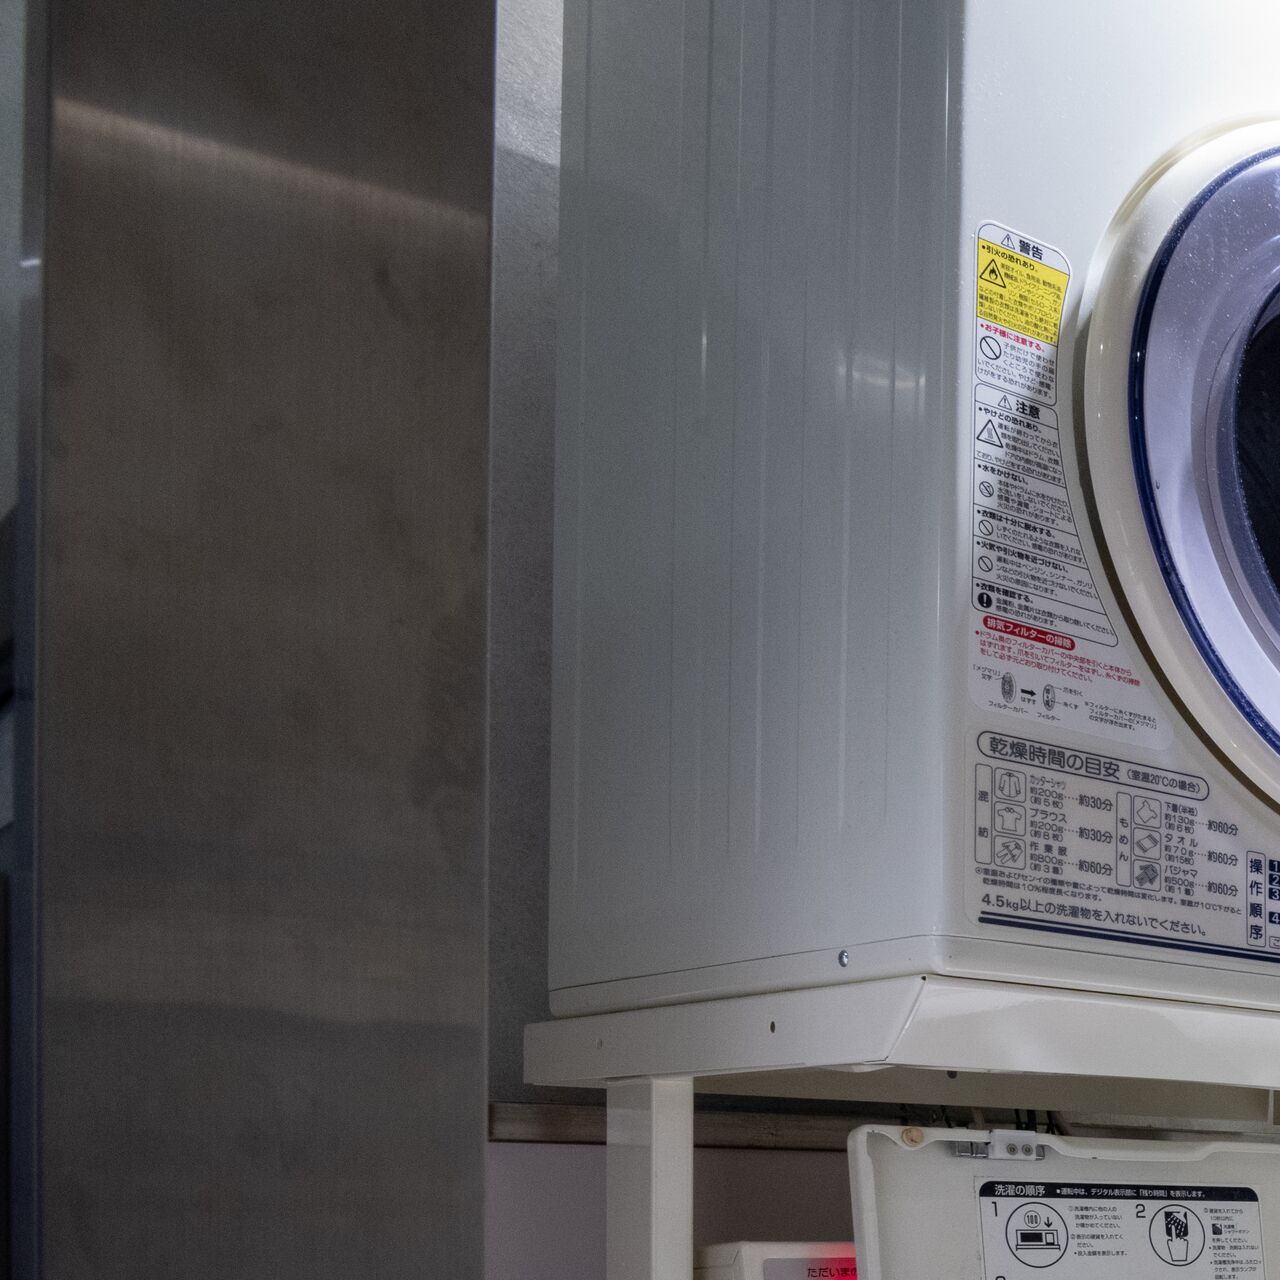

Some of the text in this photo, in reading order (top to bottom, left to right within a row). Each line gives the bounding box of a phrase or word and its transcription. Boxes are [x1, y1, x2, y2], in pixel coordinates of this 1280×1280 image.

[1019, 239, 1043, 260] 警告
[1016, 400, 1040, 419] 注意
[987, 617, 1072, 649] 排気フィルターの掃除
[989, 736, 1120, 780] 乾燥時間の目安
[1079, 794, 1112, 811] 約30分
[1030, 808, 1067, 823] ブラウス
[1079, 827, 1112, 844] 約30分
[1208, 820, 1238, 836] 約60分
[1208, 850, 1238, 866] 約60分
[1079, 860, 1112, 876] 約60分
[1165, 865, 1198, 878] パジャマ
[1272, 861, 1279, 871] 1
[1272, 876, 1280, 885] 2
[1208, 881, 1238, 896] 約60分
[1272, 891, 1280, 900] 3
[1249, 858, 1263, 940] 操作順序
[1272, 913, 1280, 924] 4
[994, 1184, 1045, 1196] 洗濯の順序
[992, 1202, 997, 1216] 1
[1135, 1204, 1146, 1218] 2
